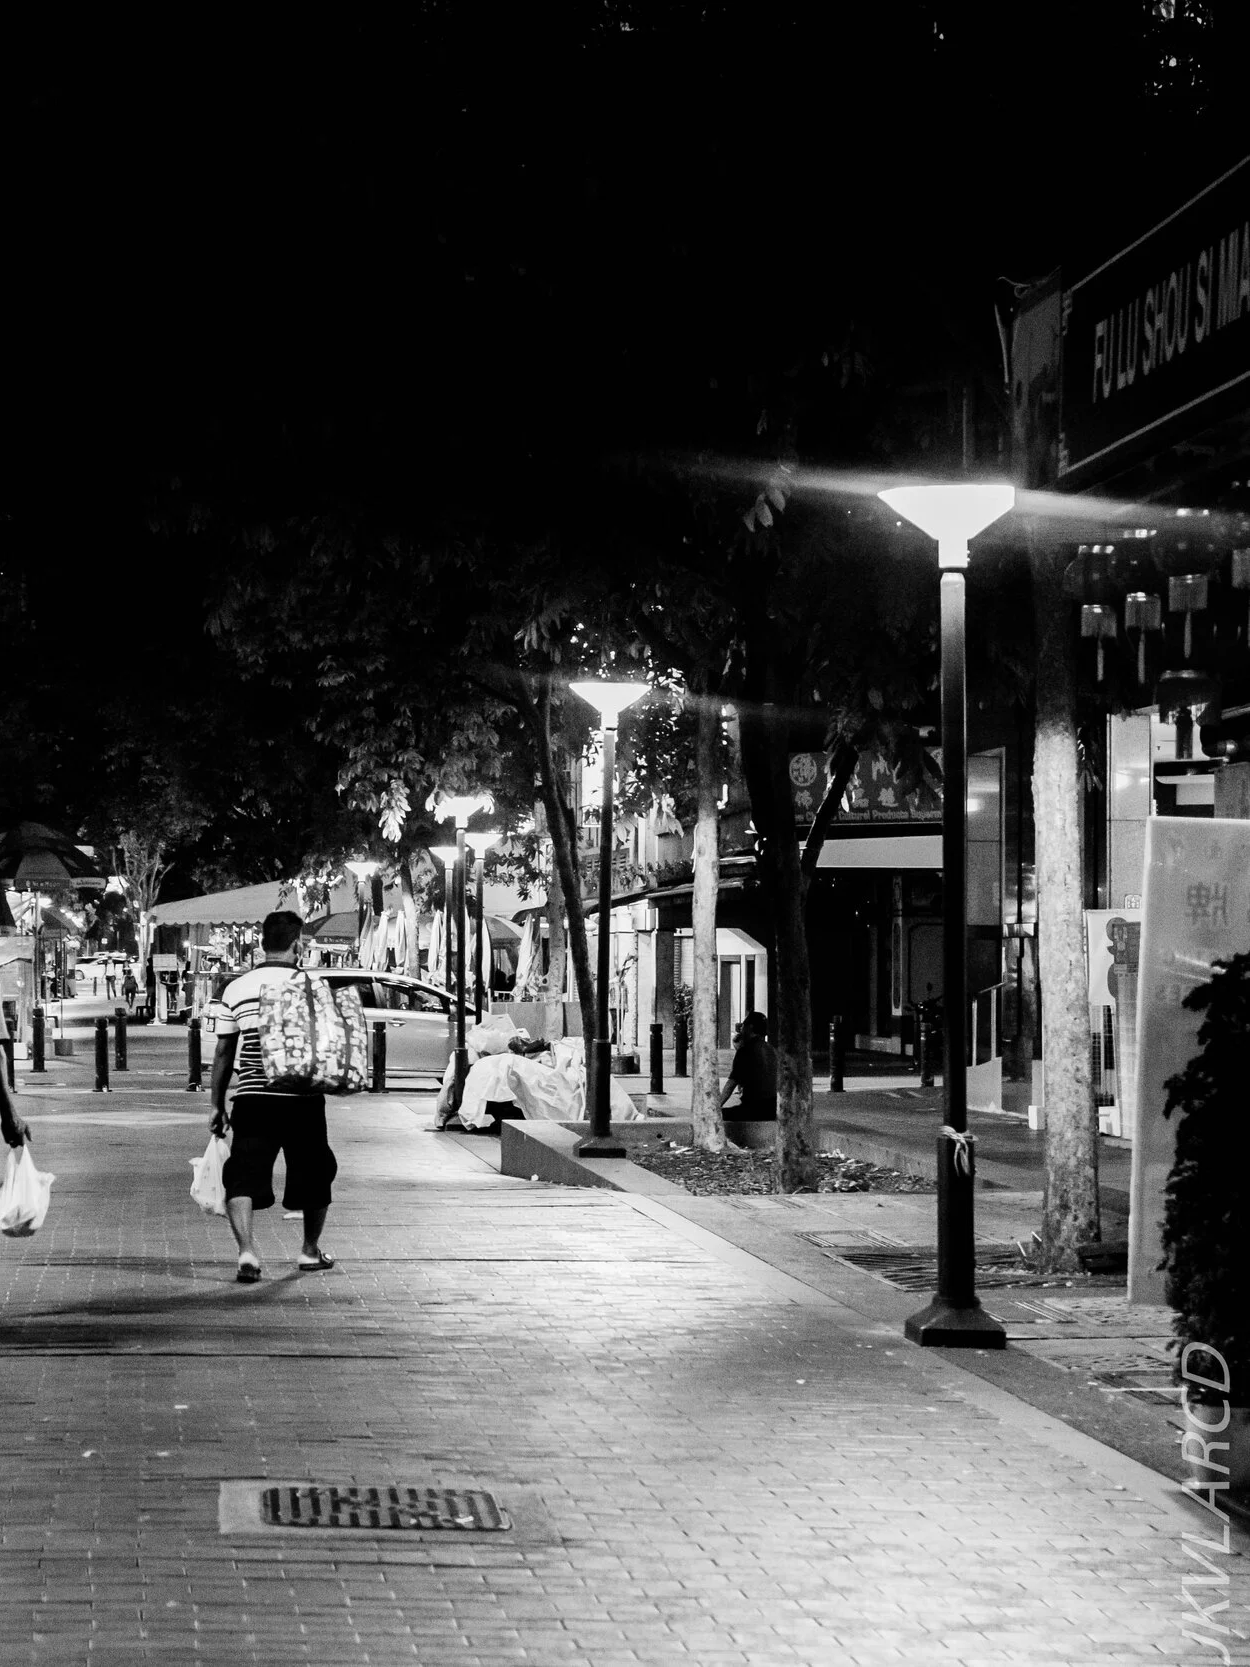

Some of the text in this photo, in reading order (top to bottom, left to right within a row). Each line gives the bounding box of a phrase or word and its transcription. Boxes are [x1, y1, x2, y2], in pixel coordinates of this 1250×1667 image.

[1092, 313, 1116, 404] FU
[1116, 297, 1141, 391] LU
[1142, 262, 1191, 376] SHOU
[1194, 246, 1215, 344] SI
[838, 809, 943, 822] Cultural Products Superm
